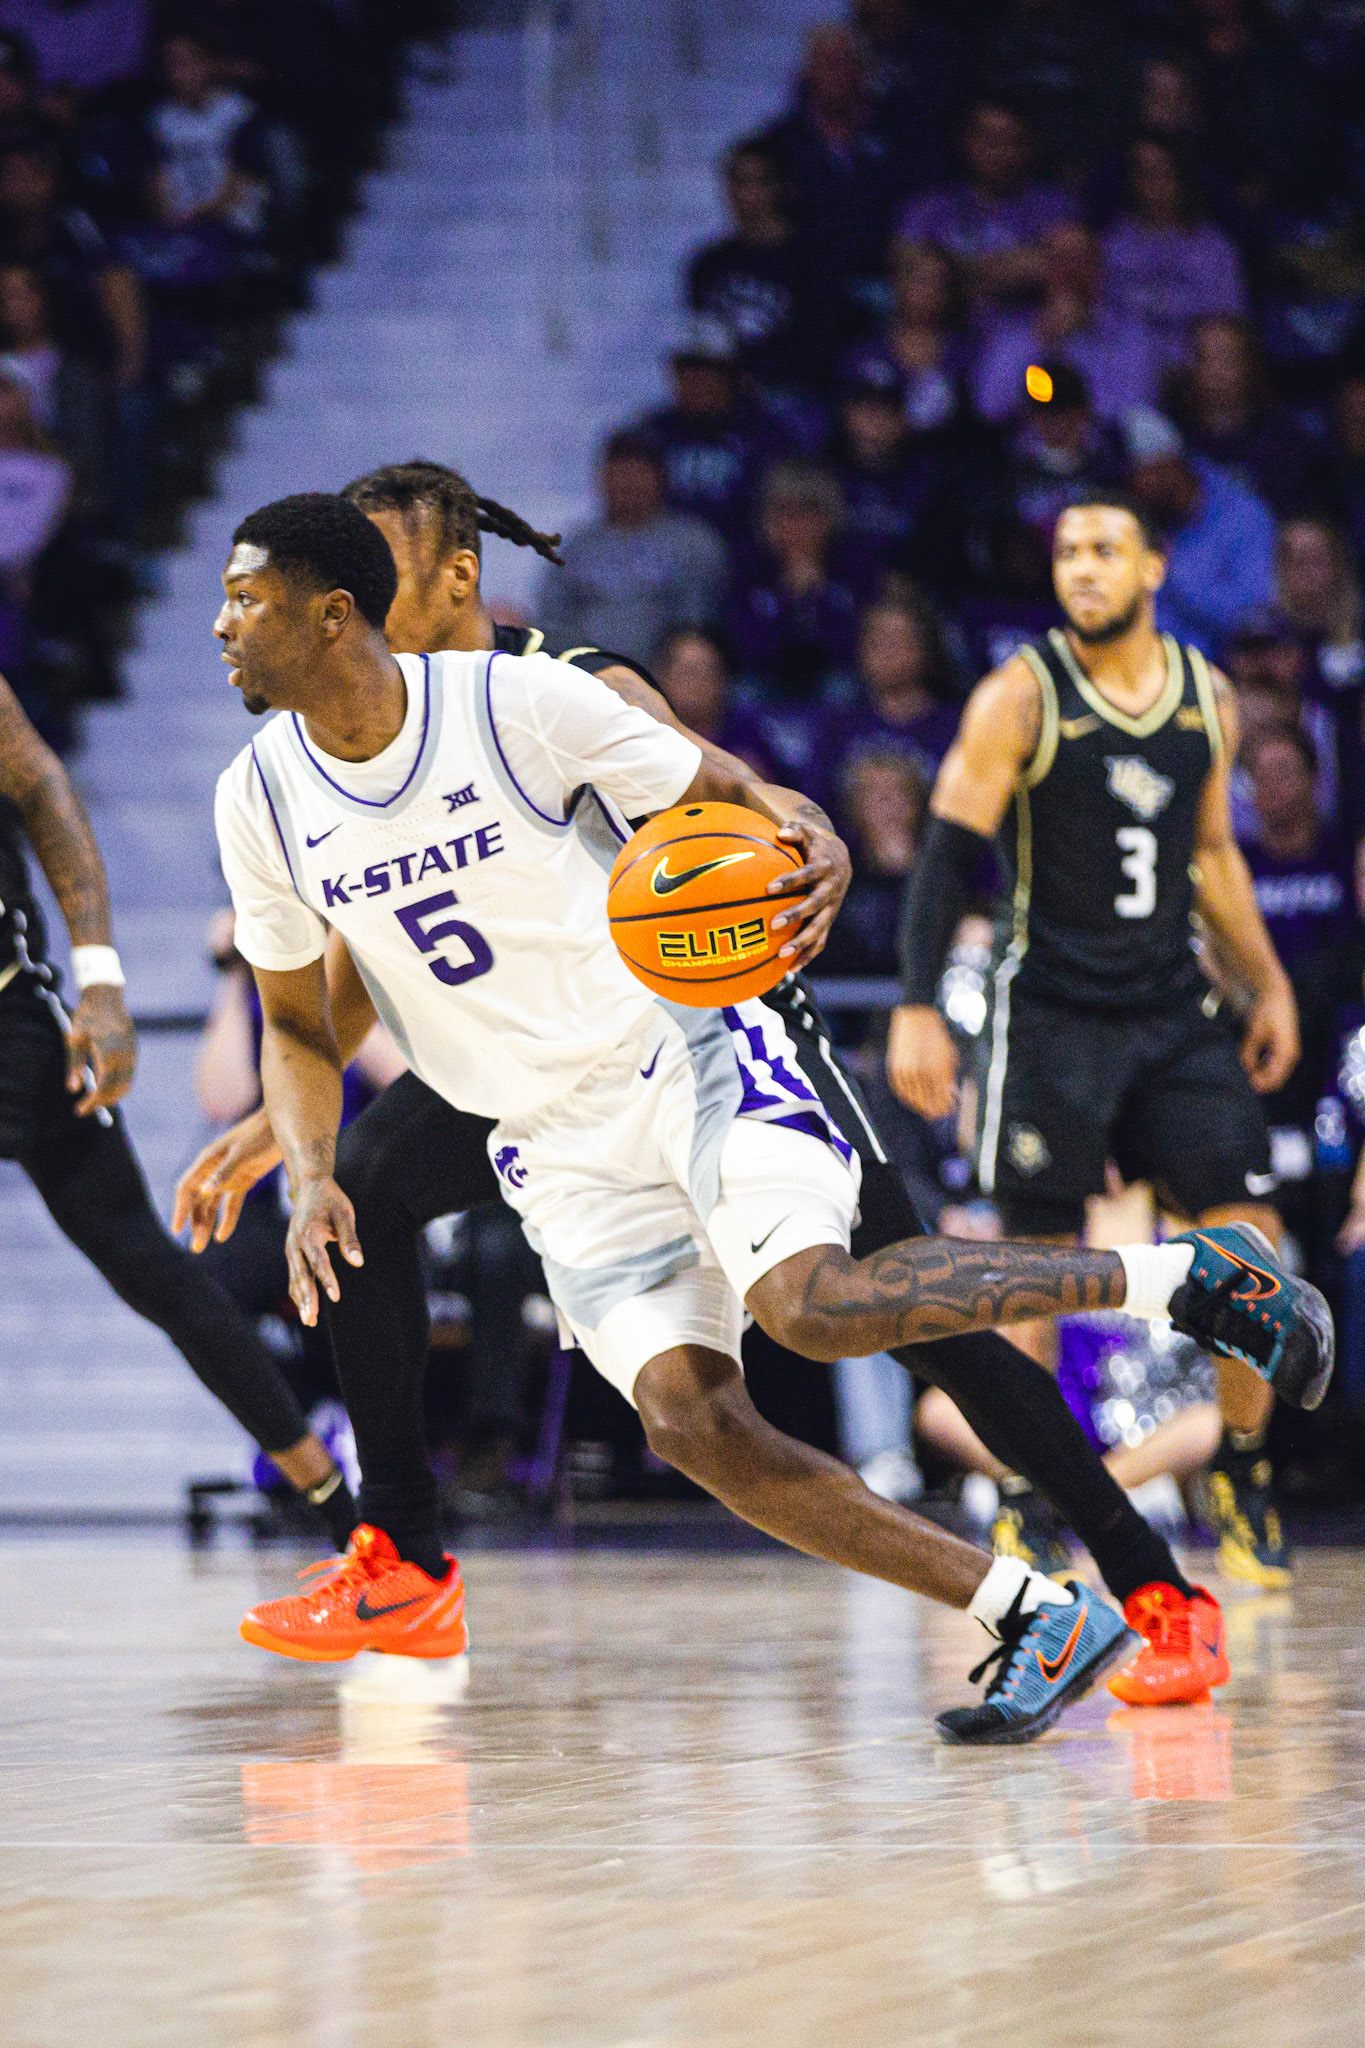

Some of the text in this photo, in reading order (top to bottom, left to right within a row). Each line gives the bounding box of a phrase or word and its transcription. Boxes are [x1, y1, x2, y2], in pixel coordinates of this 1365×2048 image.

[321, 821, 505, 908] K-STATE
[1114, 826, 1158, 919] 3
[393, 889, 495, 986] 5
[658, 917, 767, 958] ELITE
[661, 945, 769, 968] CHAMPIONSHIP
